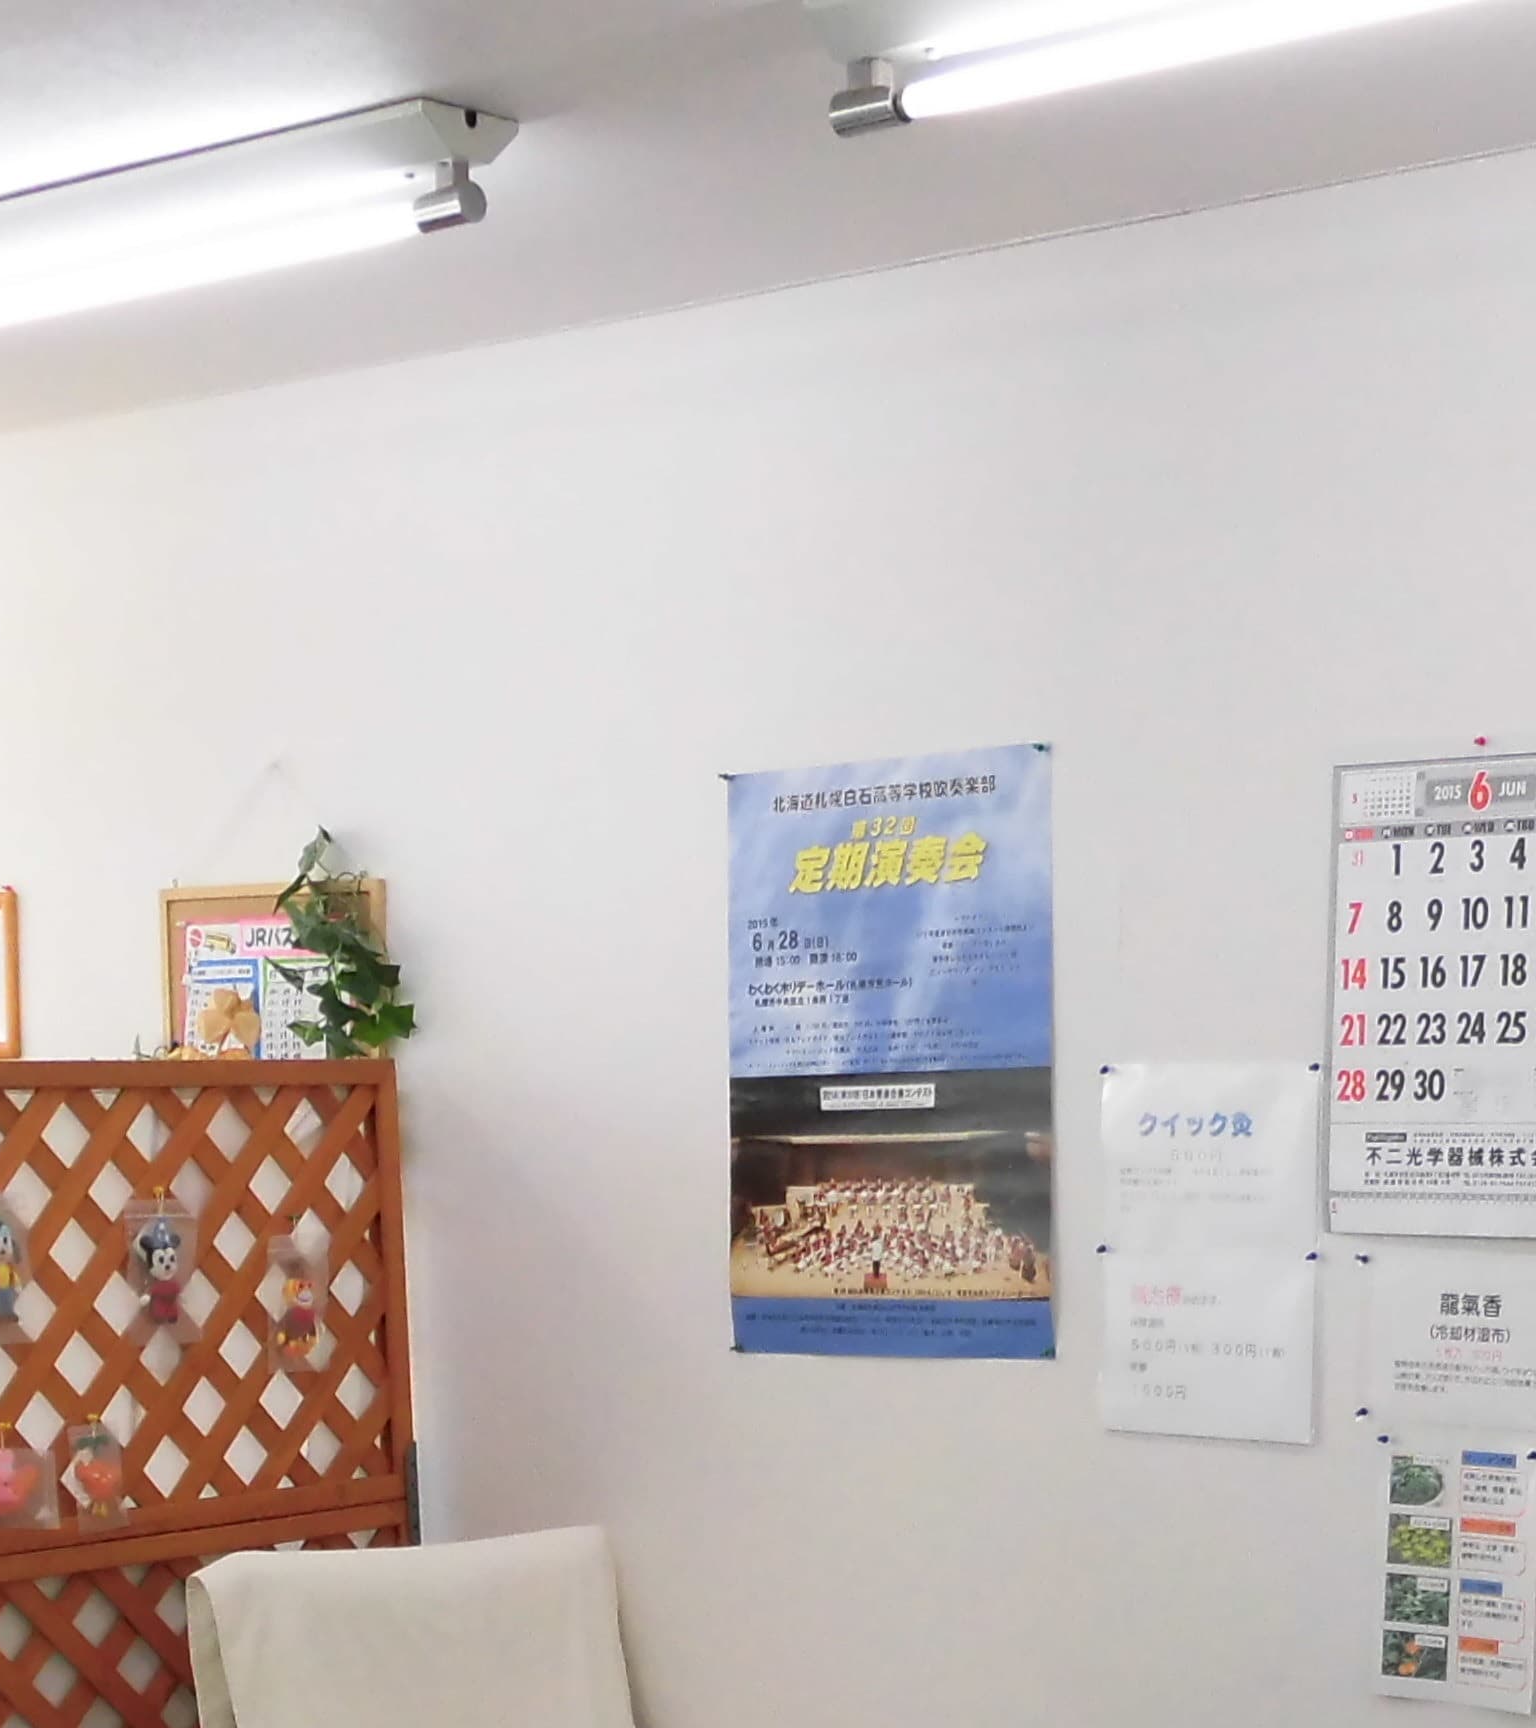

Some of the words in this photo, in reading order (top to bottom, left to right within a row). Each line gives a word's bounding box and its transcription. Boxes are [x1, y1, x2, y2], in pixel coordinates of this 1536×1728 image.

[1433, 785, 1463, 801] 2015
[1467, 770, 1493, 811] 6
[1498, 782, 1527, 798] JUN
[788, 831, 988, 894] 定期演奏会
[1392, 844, 1402, 876] 1
[1429, 841, 1445, 874] 2
[1470, 839, 1485, 872] 3
[1510, 837, 1526, 870] 4
[1348, 902, 1363, 934] 7
[1387, 900, 1402, 933] 8
[1427, 898, 1443, 931] 9
[1462, 897, 1489, 930] 10
[1504, 895, 1530, 928] 11
[1341, 958, 1366, 990] 14
[1381, 957, 1406, 989] 15
[1420, 955, 1446, 988] 16
[1460, 955, 1487, 987] 17
[1500, 953, 1527, 986] 18
[1340, 1014, 1365, 1046] 21
[1377, 1013, 1406, 1046] 22
[1416, 1012, 1446, 1045] 23
[1456, 1011, 1486, 1045] 24
[1496, 1011, 1527, 1044] 25
[1337, 1070, 1365, 1102] 28
[1375, 1069, 1405, 1101] 29
[1413, 1069, 1445, 1101] 30
